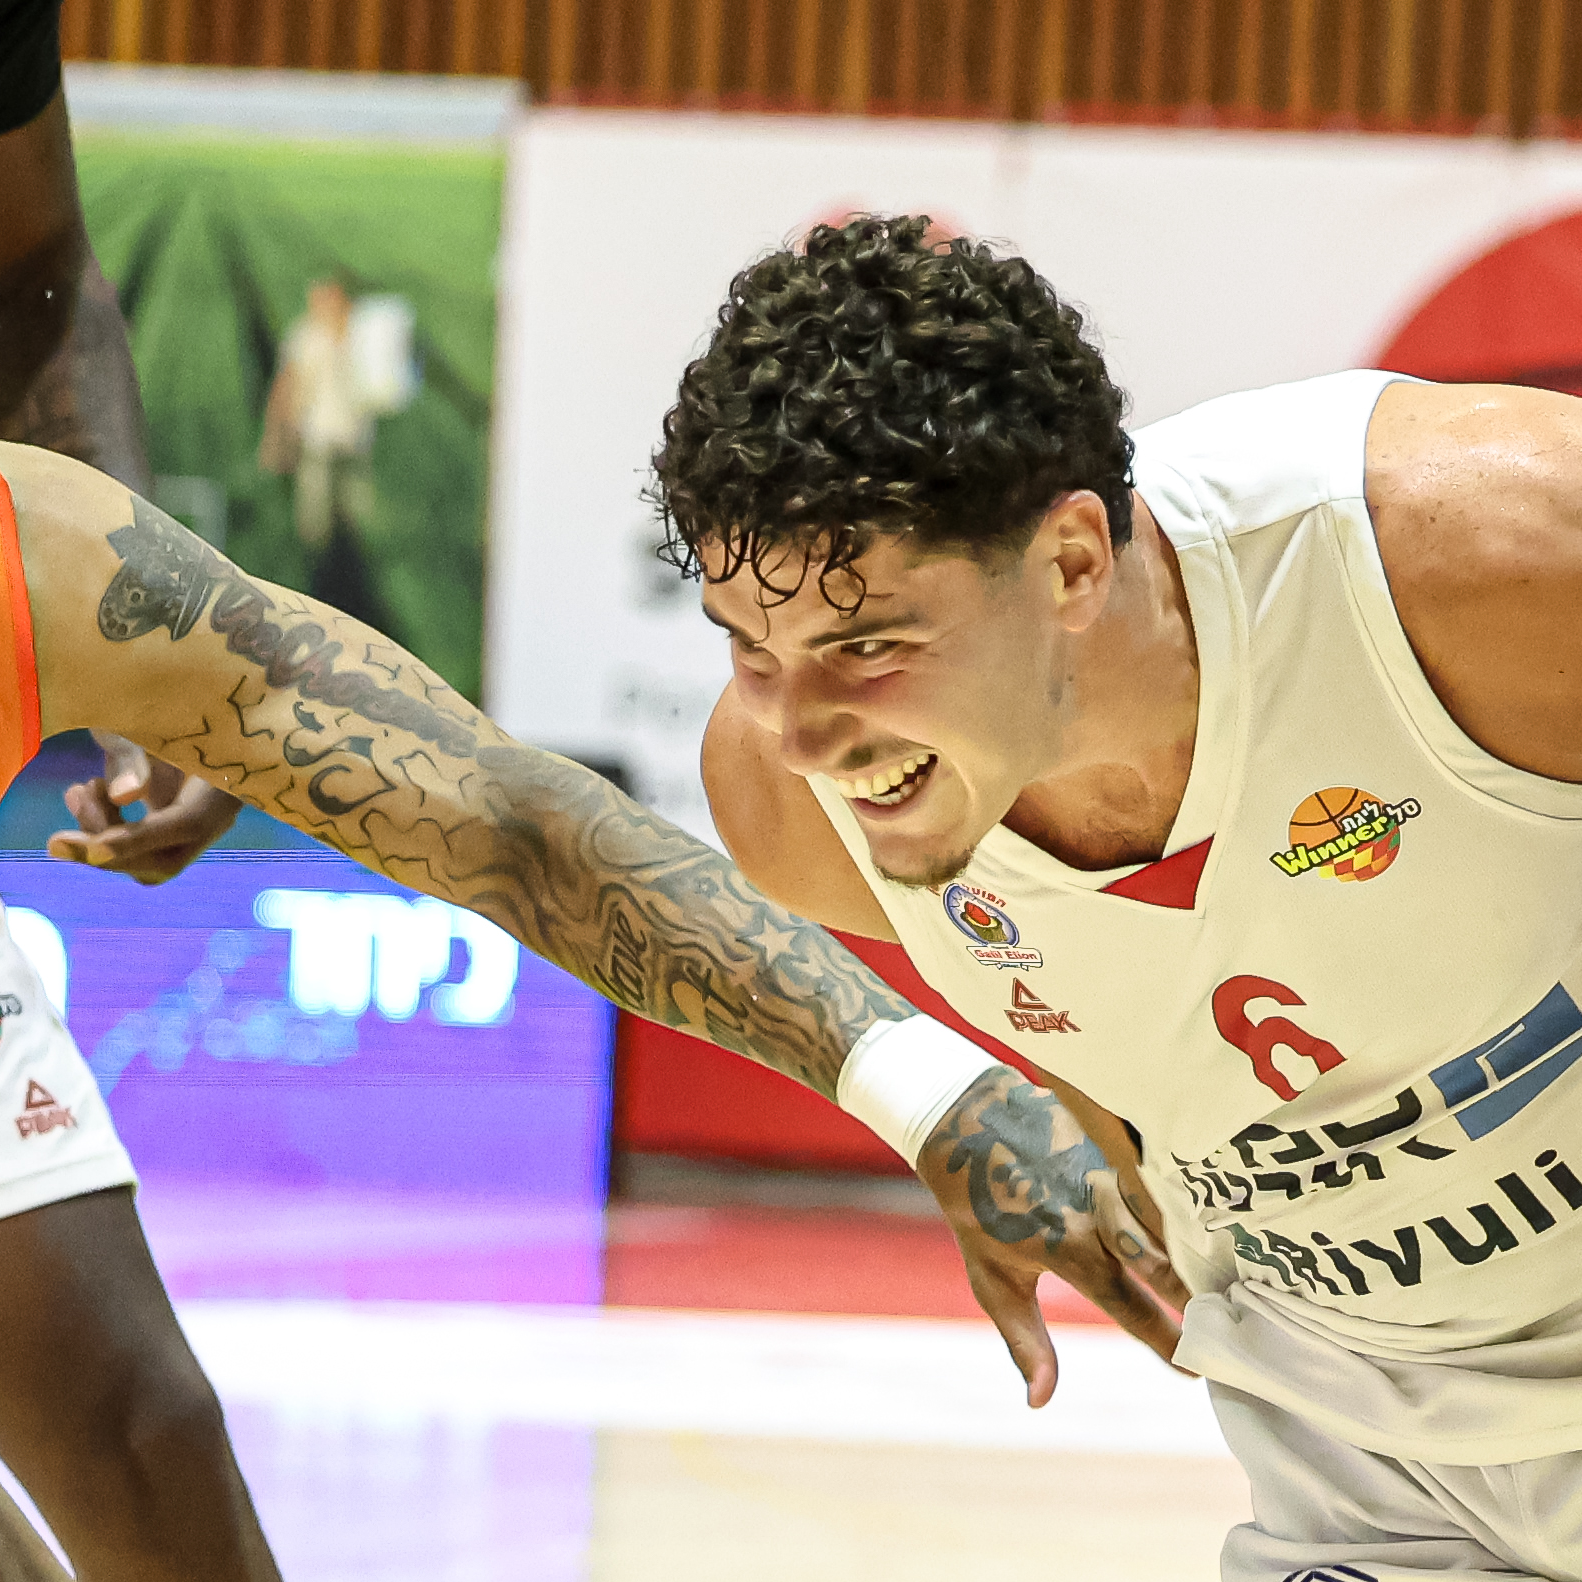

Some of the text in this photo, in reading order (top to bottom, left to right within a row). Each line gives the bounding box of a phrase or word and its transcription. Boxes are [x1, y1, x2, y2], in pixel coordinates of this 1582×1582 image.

[1272, 800, 1418, 875] Winner סל
[1341, 802, 1379, 832] ליגת
[1004, 1010, 1082, 1034] PEAK
[1212, 975, 1348, 1102] 6
